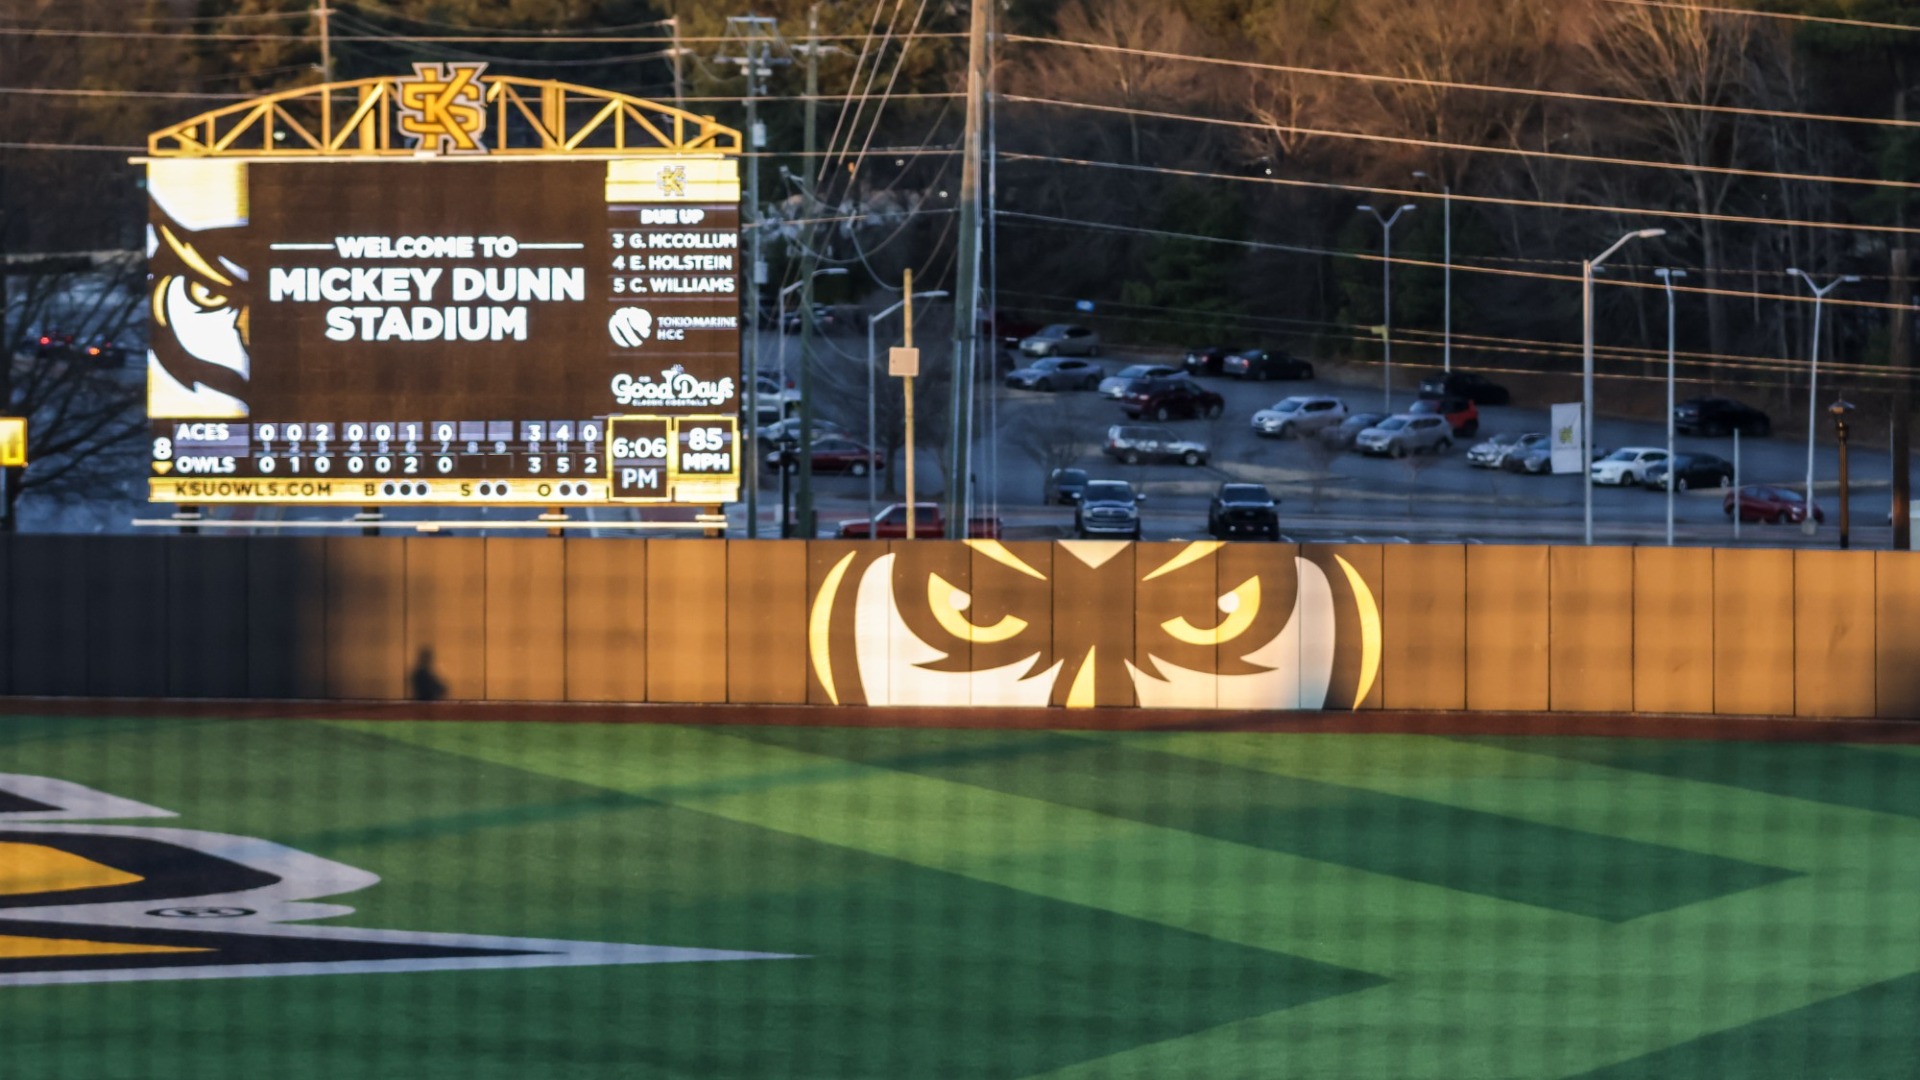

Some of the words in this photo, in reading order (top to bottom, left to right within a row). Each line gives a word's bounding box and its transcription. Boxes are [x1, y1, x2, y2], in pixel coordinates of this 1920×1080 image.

[641, 209, 678, 224] DUE
[679, 209, 704, 224] UP
[335, 236, 474, 258] WELCOME
[478, 236, 518, 258] TO
[612, 233, 624, 249] 3
[629, 233, 646, 249] G.
[648, 233, 737, 249] MCCOLLUM
[612, 255, 625, 270] 4
[629, 255, 646, 270] E.
[648, 255, 732, 270] HOLSTEIN
[269, 267, 443, 302] MICKEY
[452, 267, 585, 302] DUNN
[613, 277, 625, 293] 5
[629, 277, 647, 293] C.
[649, 277, 735, 293] WILLIAMS
[325, 306, 527, 341] STADIUM
[657, 329, 684, 340] HCC
[611, 369, 675, 405] Good
[176, 423, 229, 441] ACES
[259, 424, 275, 441] 0
[286, 424, 302, 441] 0
[316, 424, 329, 441] 2
[348, 424, 363, 441] 0
[375, 424, 391, 441] 0
[407, 424, 416, 441] 1
[438, 424, 452, 441] 0
[528, 424, 541, 441] 3
[556, 424, 570, 441] 4
[583, 424, 597, 441] 0
[689, 427, 723, 451] 85
[153, 437, 172, 460] 8
[613, 437, 667, 458] 6:06
[176, 456, 236, 473] OWLS
[259, 456, 275, 473] 0
[289, 456, 300, 473] 1
[315, 456, 331, 473] 0
[348, 456, 363, 473] 0
[375, 456, 391, 473] 0
[404, 456, 418, 473] 2
[438, 456, 452, 473] 0
[528, 456, 541, 473] 3
[557, 456, 570, 473] 5
[585, 456, 597, 473] 2
[683, 453, 730, 471] MPH
[622, 468, 657, 489] PM
[175, 482, 332, 496] KSUOWLS.COM
[365, 484, 376, 496] B
[460, 484, 471, 496] S
